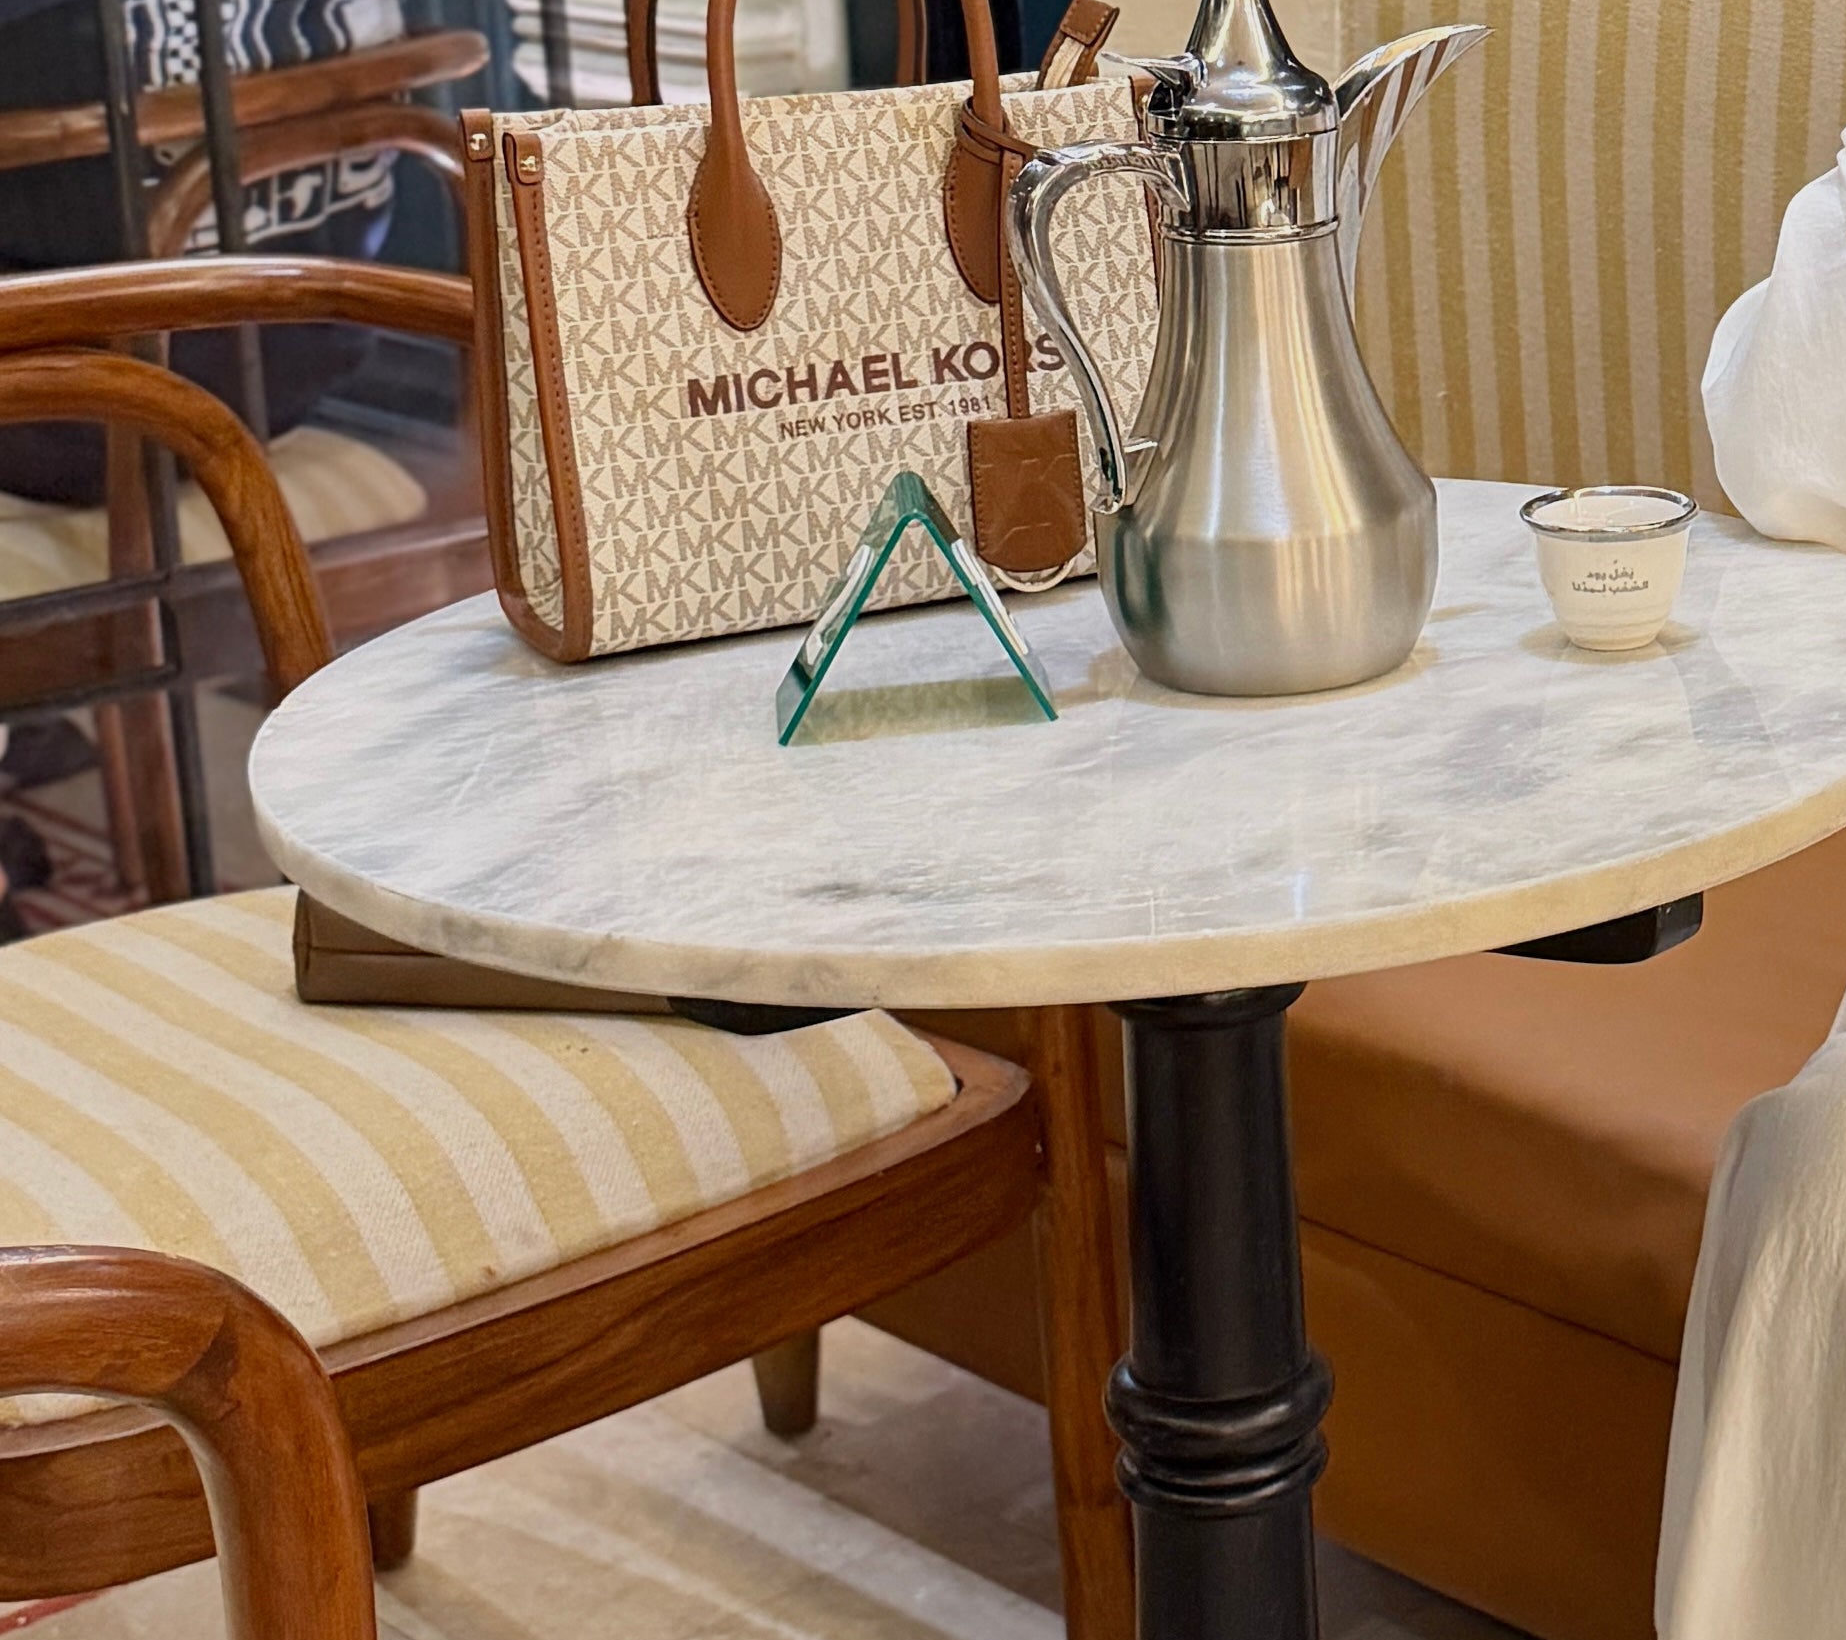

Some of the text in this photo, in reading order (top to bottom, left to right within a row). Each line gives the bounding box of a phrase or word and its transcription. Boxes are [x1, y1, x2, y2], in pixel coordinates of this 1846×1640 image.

[688, 353, 917, 418] MICHAEL
[780, 395, 991, 440] NEW YORK EST. 1981
